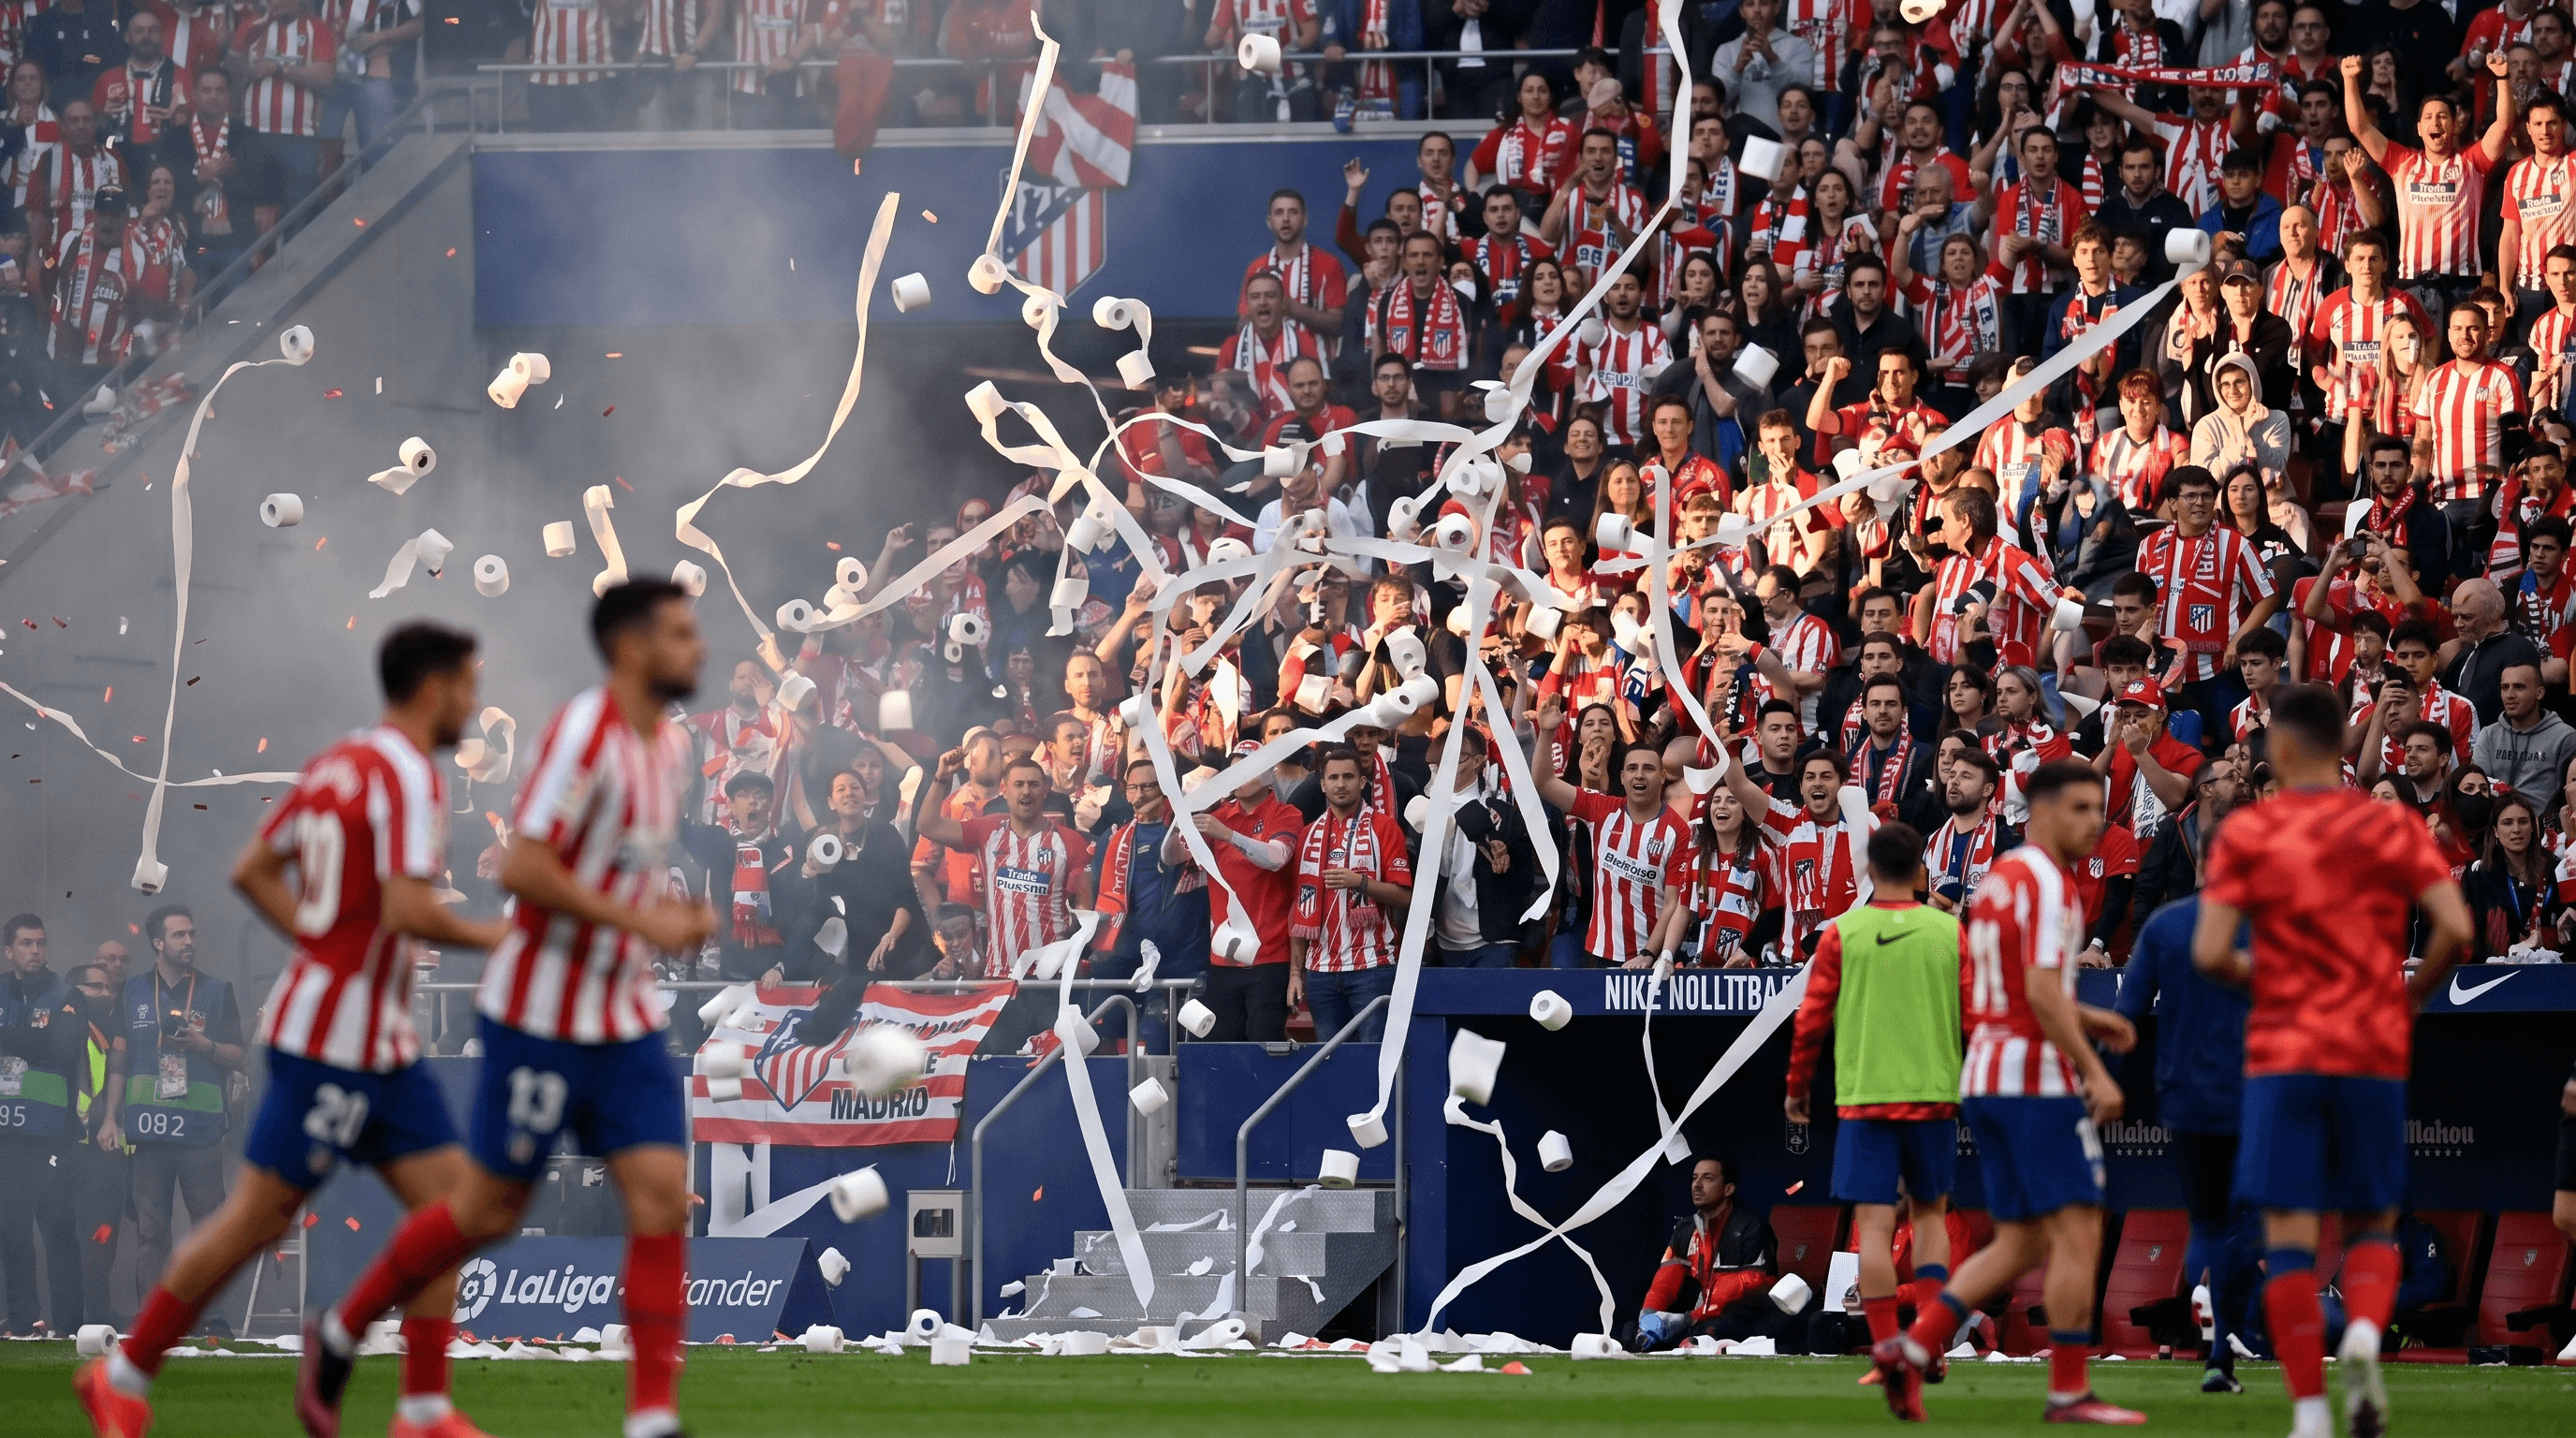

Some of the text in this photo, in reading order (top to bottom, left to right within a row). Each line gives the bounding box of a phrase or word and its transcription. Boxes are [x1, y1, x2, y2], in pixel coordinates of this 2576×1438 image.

[1006, 868, 1037, 882] Trade
[1604, 975, 1661, 1010] NIKE
[138, 1112, 184, 1137] 082
[2402, 1119, 2475, 1144] Mahou
[500, 1264, 616, 1313] LaLiga
